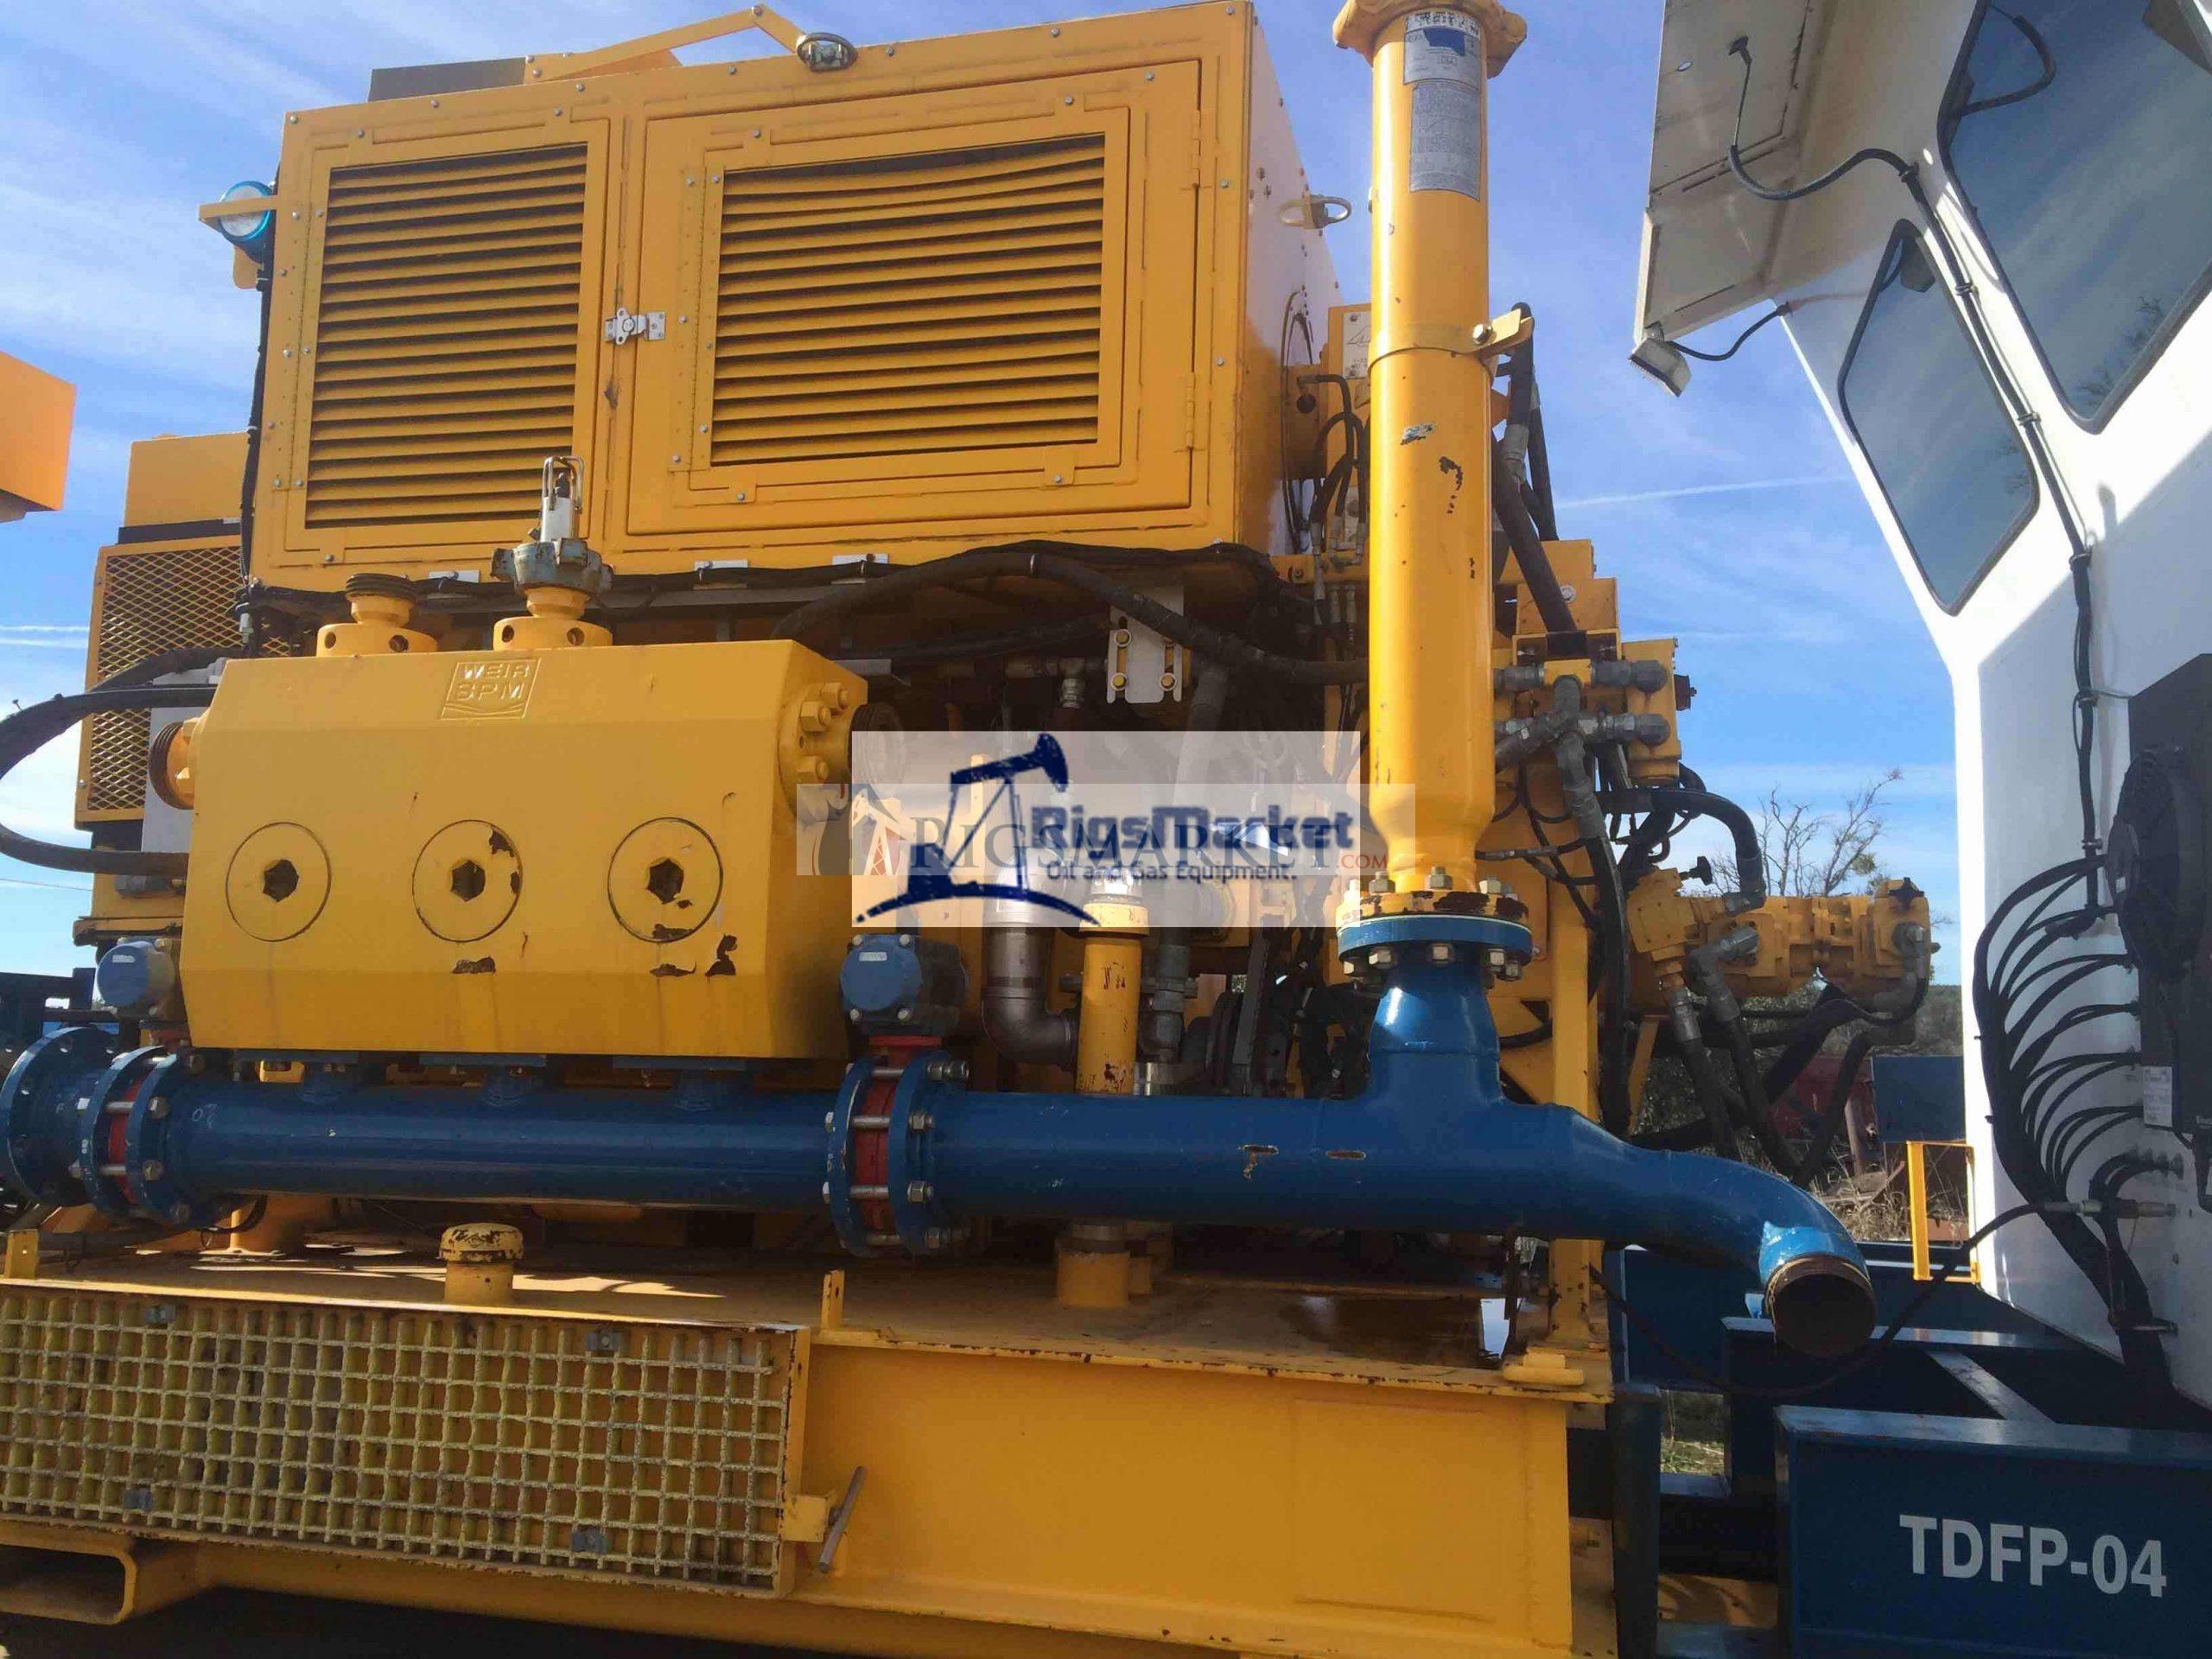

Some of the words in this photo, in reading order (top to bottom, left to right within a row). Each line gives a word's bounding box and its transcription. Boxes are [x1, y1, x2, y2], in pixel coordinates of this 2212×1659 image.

[464, 664, 531, 680] WEIR
[457, 682, 525, 702] SPM
[1899, 1514, 2168, 1598] TDFP-04
